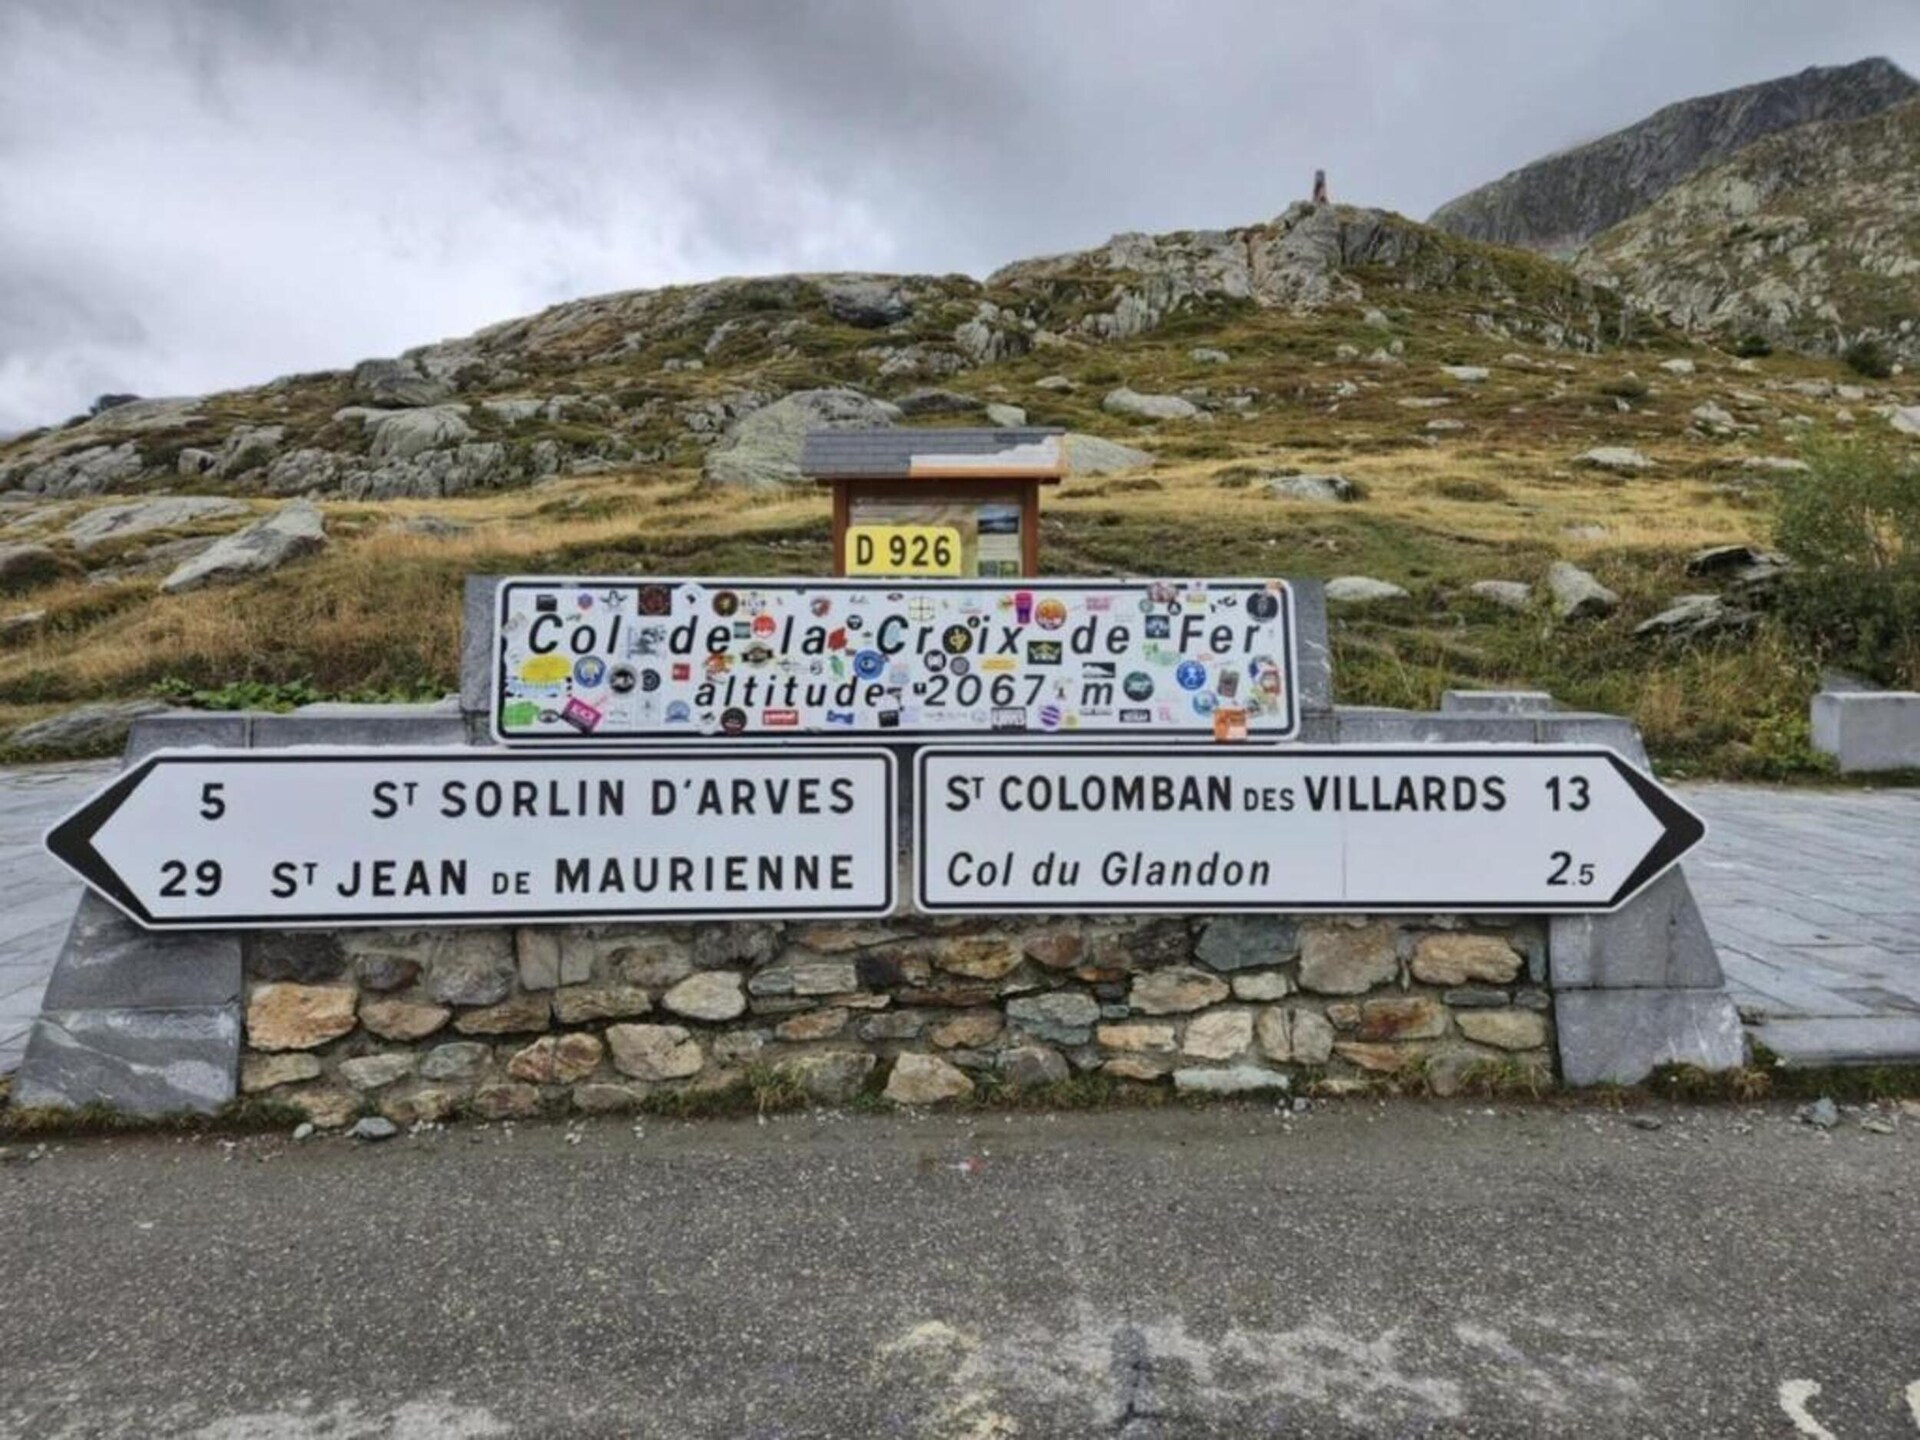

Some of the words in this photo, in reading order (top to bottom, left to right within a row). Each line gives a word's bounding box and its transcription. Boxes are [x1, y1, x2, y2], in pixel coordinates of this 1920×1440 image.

[857, 535, 873, 566] D
[889, 535, 951, 567] 926
[529, 613, 621, 654] Col
[669, 615, 731, 655] de
[781, 615, 826, 655] la
[877, 614, 1024, 655] Crix
[1071, 615, 1130, 655] de
[1178, 614, 1261, 654] Fer
[695, 675, 884, 707] altitude
[924, 674, 1046, 707] 2067
[1081, 681, 1114, 706] m
[200, 783, 226, 820] 5
[440, 780, 625, 818] SORLIN
[651, 778, 855, 816] D'ARVES
[1000, 775, 1232, 812] COLOMBAN
[1244, 788, 1294, 812] DES
[1304, 775, 1507, 812] VILLARDS
[1545, 776, 1591, 811] 13
[159, 860, 223, 898] 29
[337, 859, 467, 897] JEAN
[492, 871, 530, 895] DE
[555, 855, 854, 894] MAURIENNE
[947, 851, 1014, 887] Col
[1032, 851, 1080, 887] du
[1101, 851, 1271, 887] Glandon
[1546, 851, 1595, 887] 2.5
